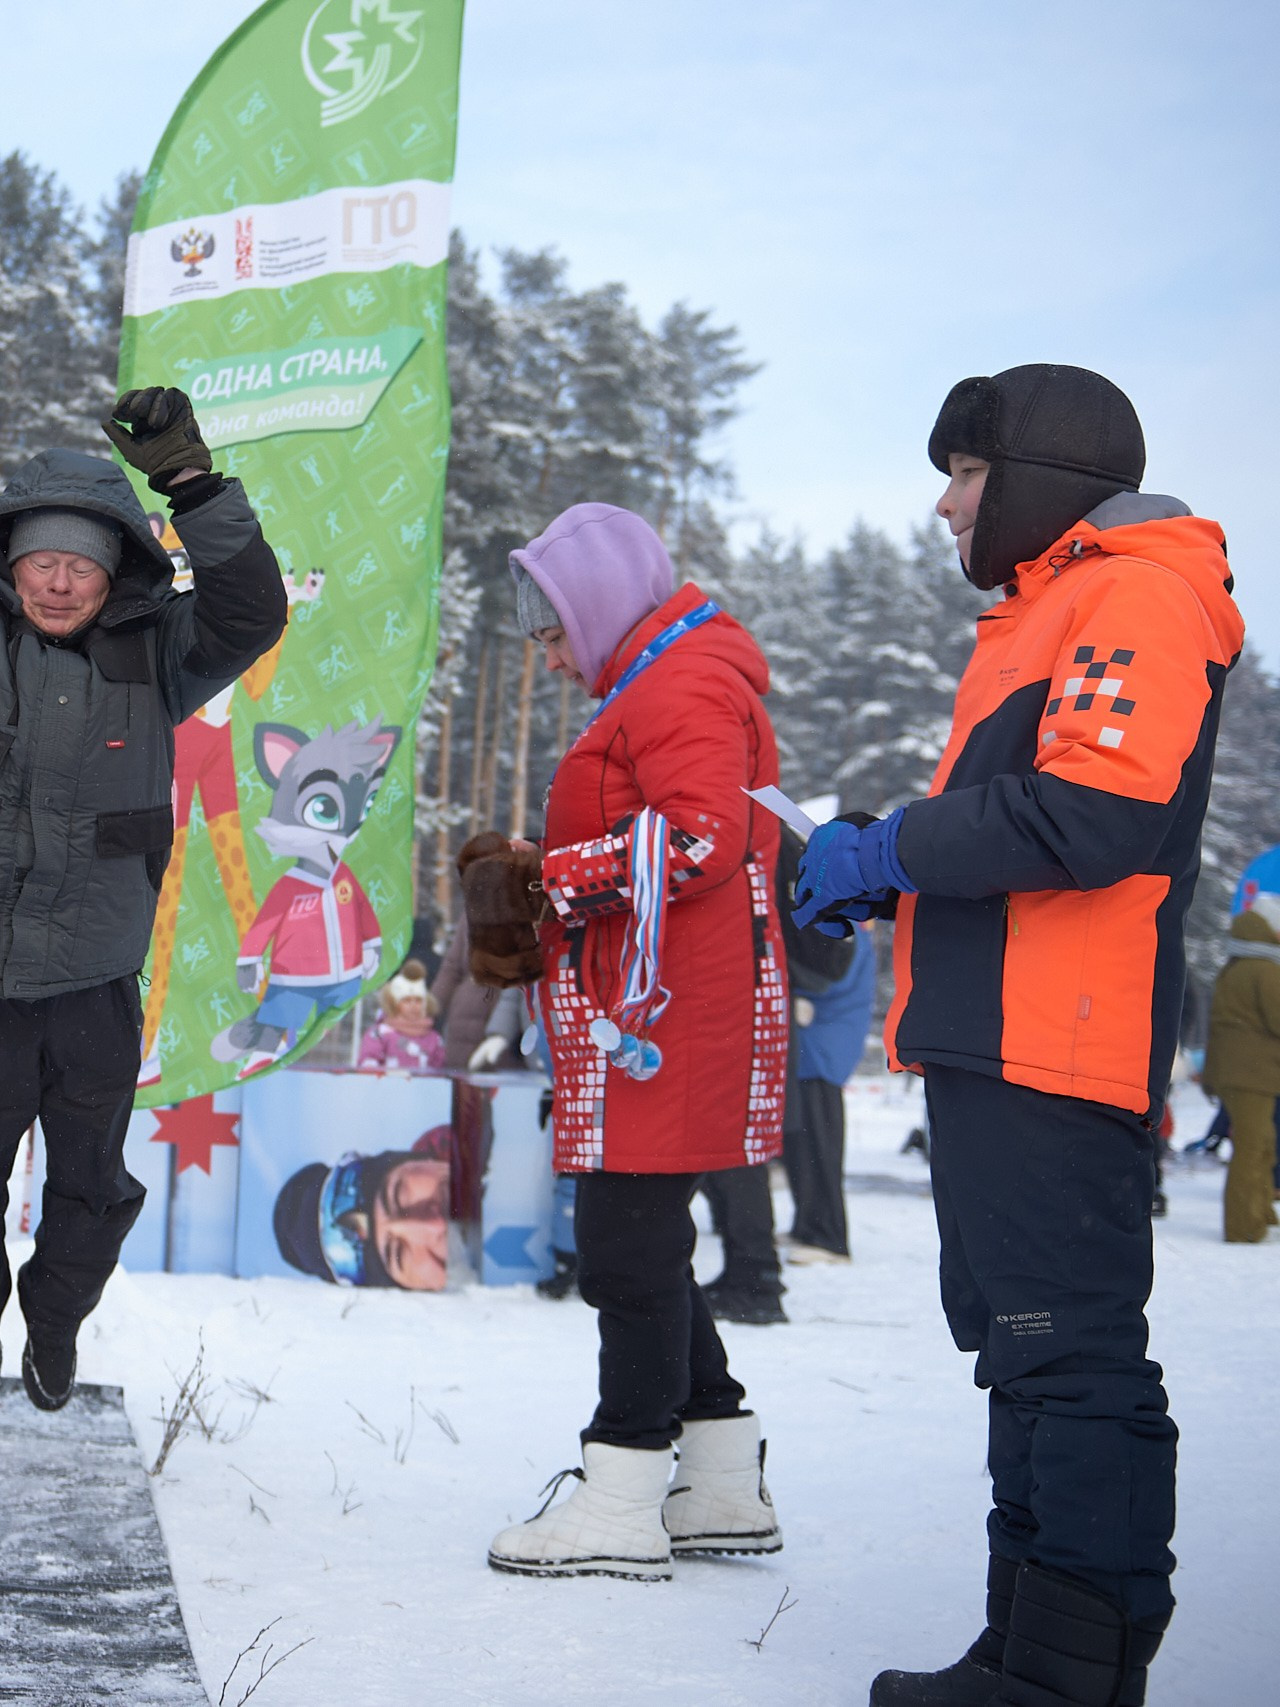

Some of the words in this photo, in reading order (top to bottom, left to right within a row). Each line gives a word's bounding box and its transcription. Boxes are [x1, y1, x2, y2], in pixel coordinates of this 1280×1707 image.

[342, 190, 417, 245] ГТО
[191, 363, 272, 401] ОДНА
[279, 344, 388, 384] СТРАНА,
[256, 392, 365, 429] команда!
[1009, 1311, 1051, 1321] KEROM
[1012, 1321, 1051, 1329] EXTREME
